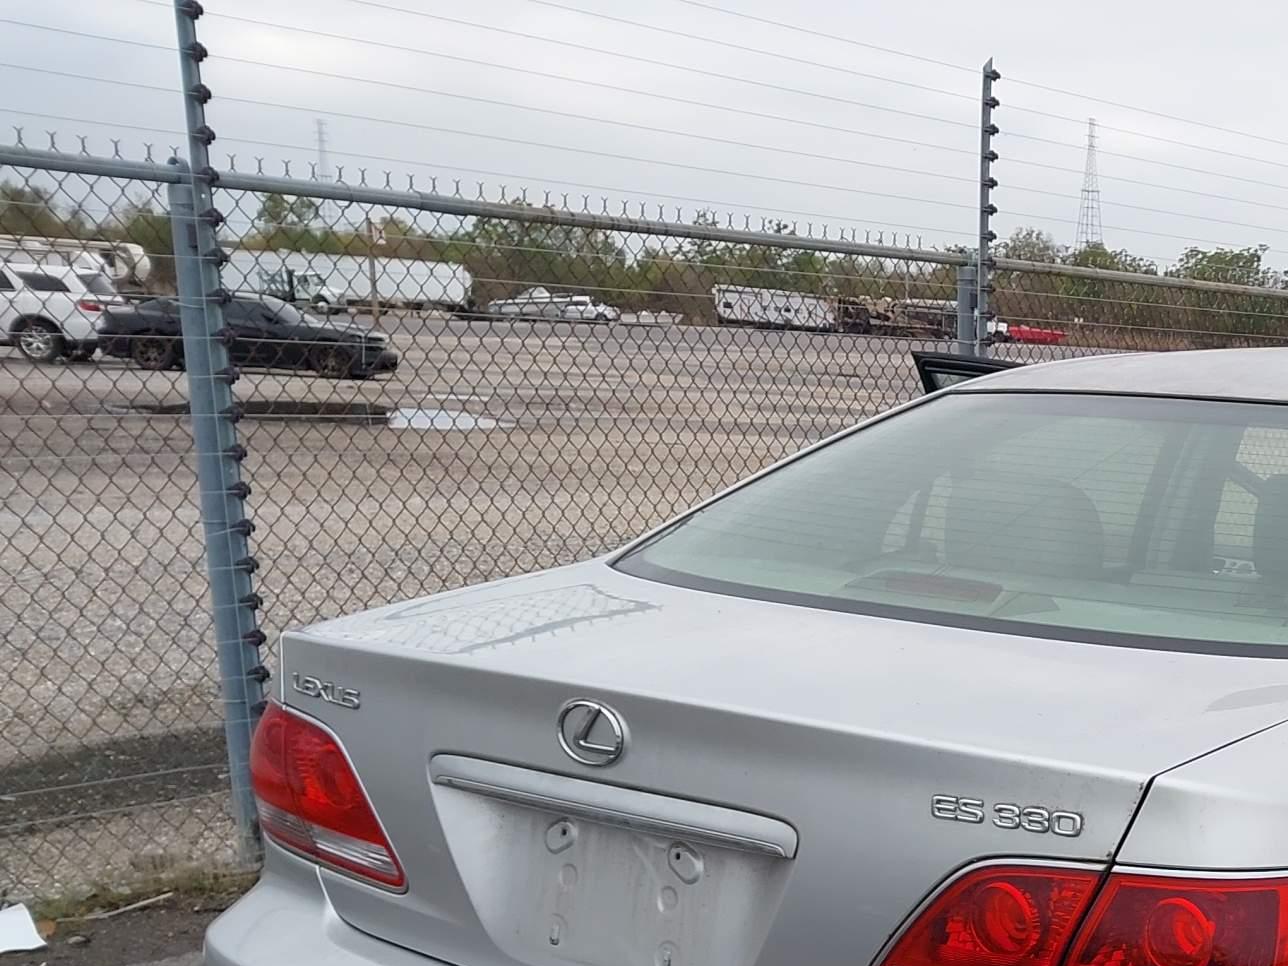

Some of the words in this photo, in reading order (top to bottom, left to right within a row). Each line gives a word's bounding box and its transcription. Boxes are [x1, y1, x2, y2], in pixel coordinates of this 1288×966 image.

[293, 672, 360, 709] LEXUS
[932, 794, 984, 824] ES
[993, 803, 1083, 837] 330
